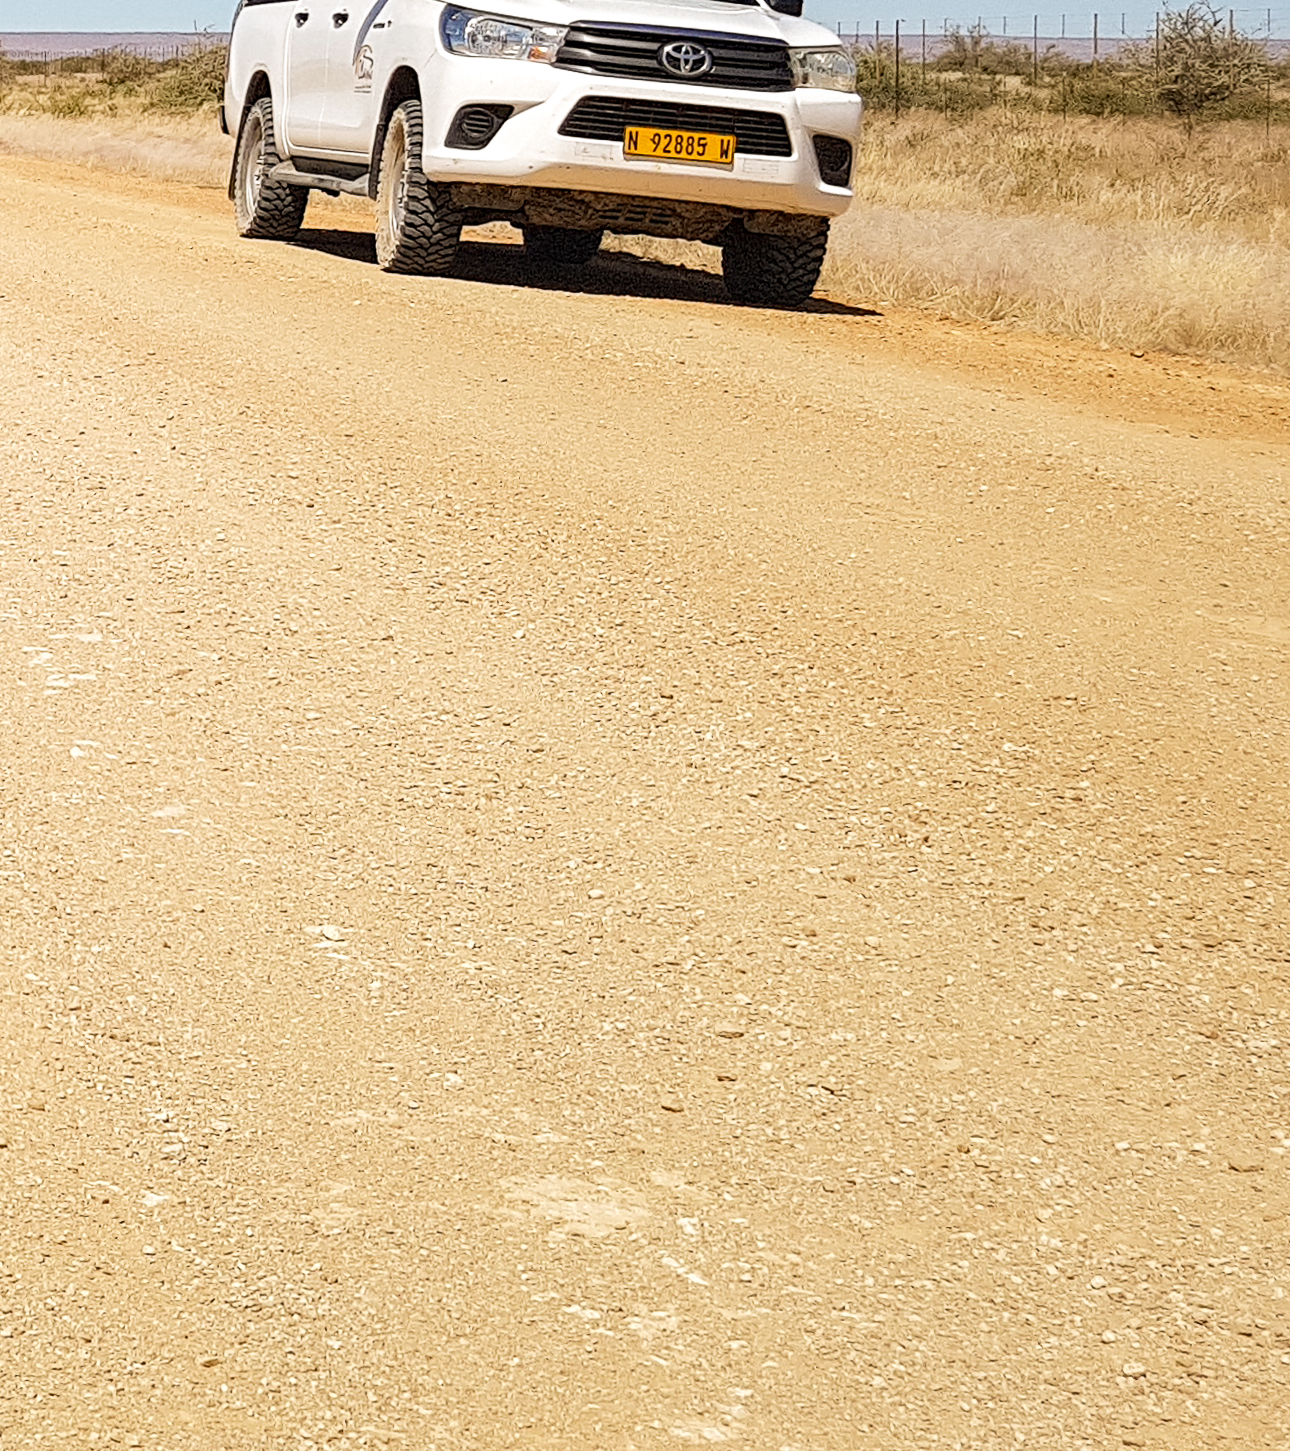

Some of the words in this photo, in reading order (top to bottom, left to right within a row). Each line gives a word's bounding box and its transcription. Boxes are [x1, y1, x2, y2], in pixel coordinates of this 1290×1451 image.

[627, 130, 639, 151] N
[650, 132, 708, 157] 92885
[719, 138, 731, 160] W
